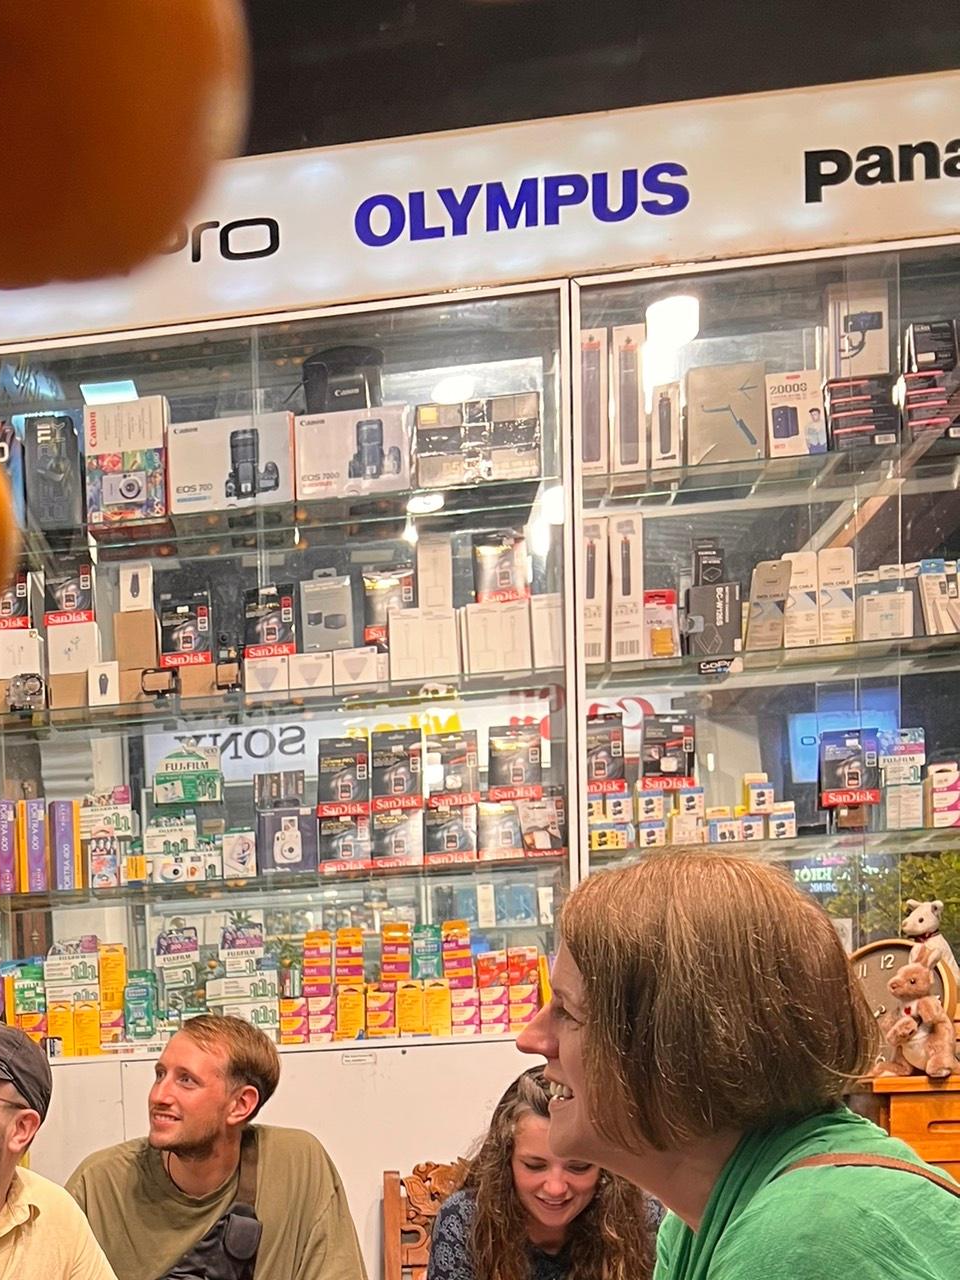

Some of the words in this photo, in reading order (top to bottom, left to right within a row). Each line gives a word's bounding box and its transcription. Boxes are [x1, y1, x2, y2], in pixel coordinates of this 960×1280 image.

[354, 162, 690, 247] OLYMPUS
[89, 411, 97, 448] Canon
[176, 485, 197, 495] EOS
[481, 588, 528, 602] SanDisk
[47, 612, 89, 624] SanDisk
[248, 645, 290, 657] SanDisk
[164, 654, 206, 666] SanDisk
[701, 660, 730, 669] GoPr
[165, 761, 209, 771] FUJIFILM
[587, 781, 619, 792] nDisk
[645, 778, 689, 789] SanDisk
[495, 788, 537, 799] SanDisk
[828, 791, 874, 802] SanDisk
[376, 798, 417, 809] SanDisk
[431, 793, 475, 808] SanDisk
[322, 804, 364, 816] SanDisk
[0, 804, 10, 834] PORTRA
[32, 804, 40, 832] PORTRA
[880, 954, 895, 969] 12
[858, 963, 867, 979] 11
